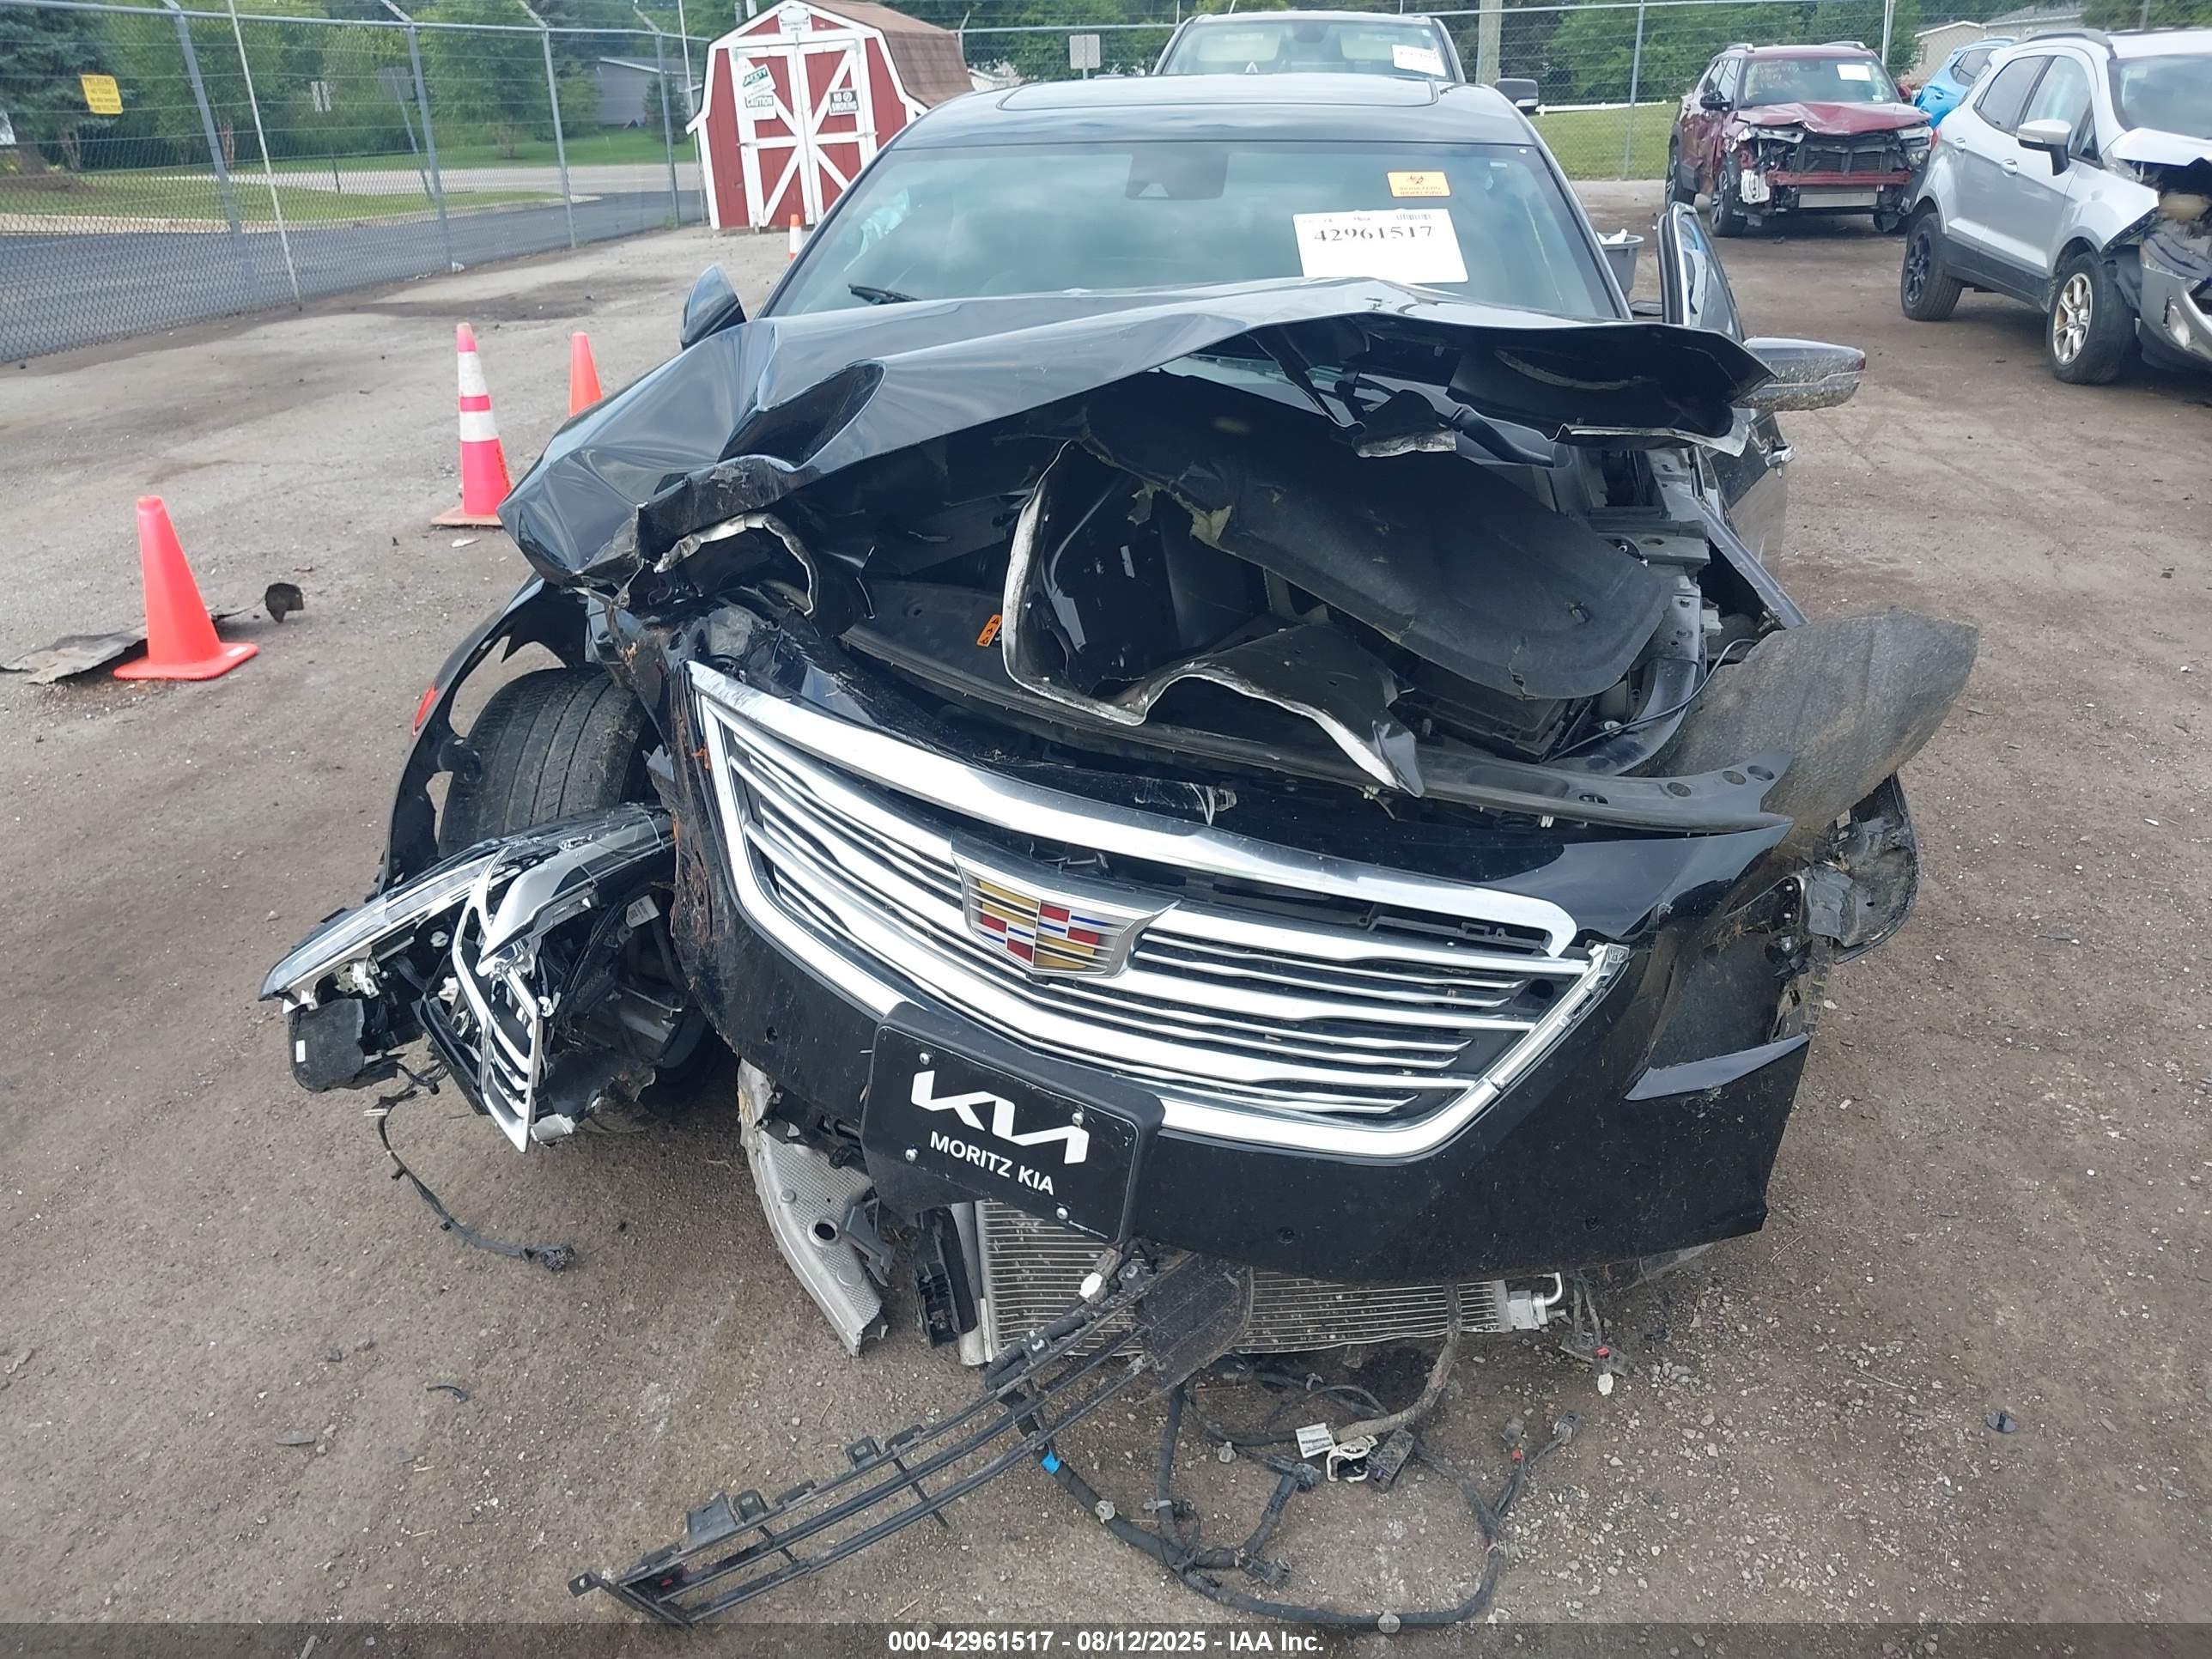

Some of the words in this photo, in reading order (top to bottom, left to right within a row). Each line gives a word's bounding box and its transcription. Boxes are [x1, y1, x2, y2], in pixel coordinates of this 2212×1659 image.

[833, 92, 842, 102] NO
[1314, 226, 1432, 241] 42961517
[930, 1131, 1013, 1178] MORITZ
[1018, 1165, 1054, 1195] KIA
